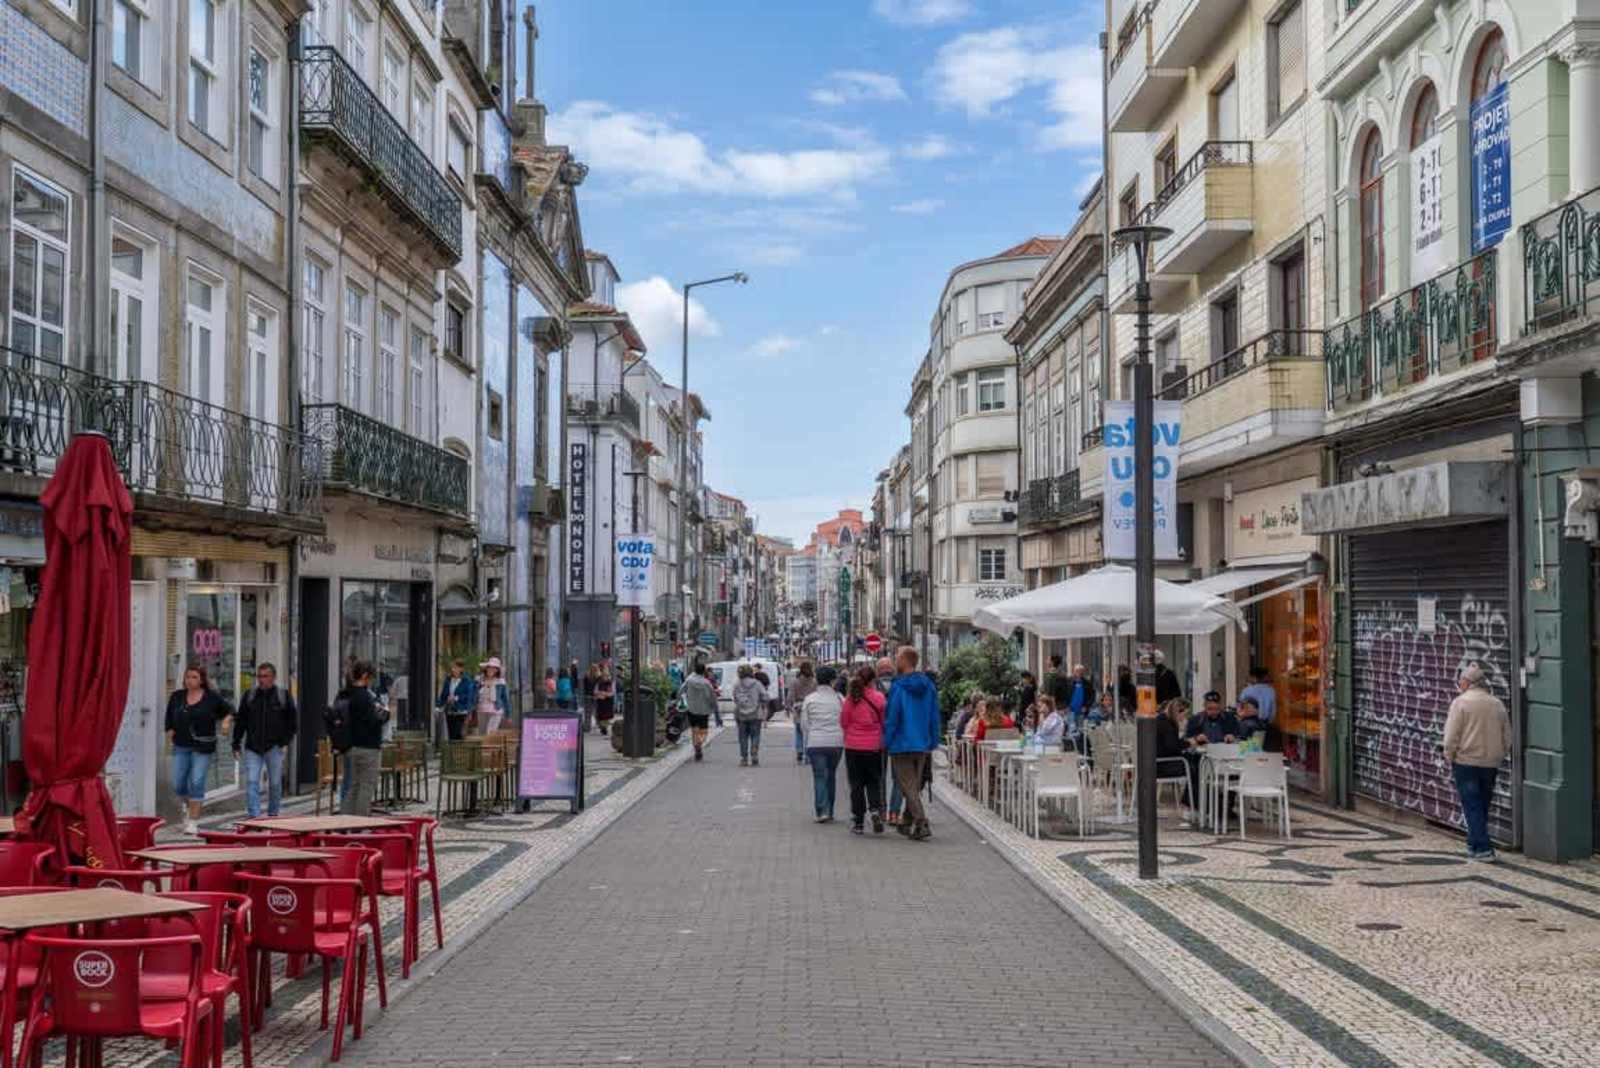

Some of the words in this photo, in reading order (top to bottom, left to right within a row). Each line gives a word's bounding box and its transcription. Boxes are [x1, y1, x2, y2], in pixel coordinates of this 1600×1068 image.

[572, 445, 584, 510] HOTEL
[570, 513, 585, 522] DO
[618, 540, 654, 554] vota
[571, 525, 584, 590] NORTE
[620, 556, 650, 568] CDU
[79, 960, 108, 970] SUPER
